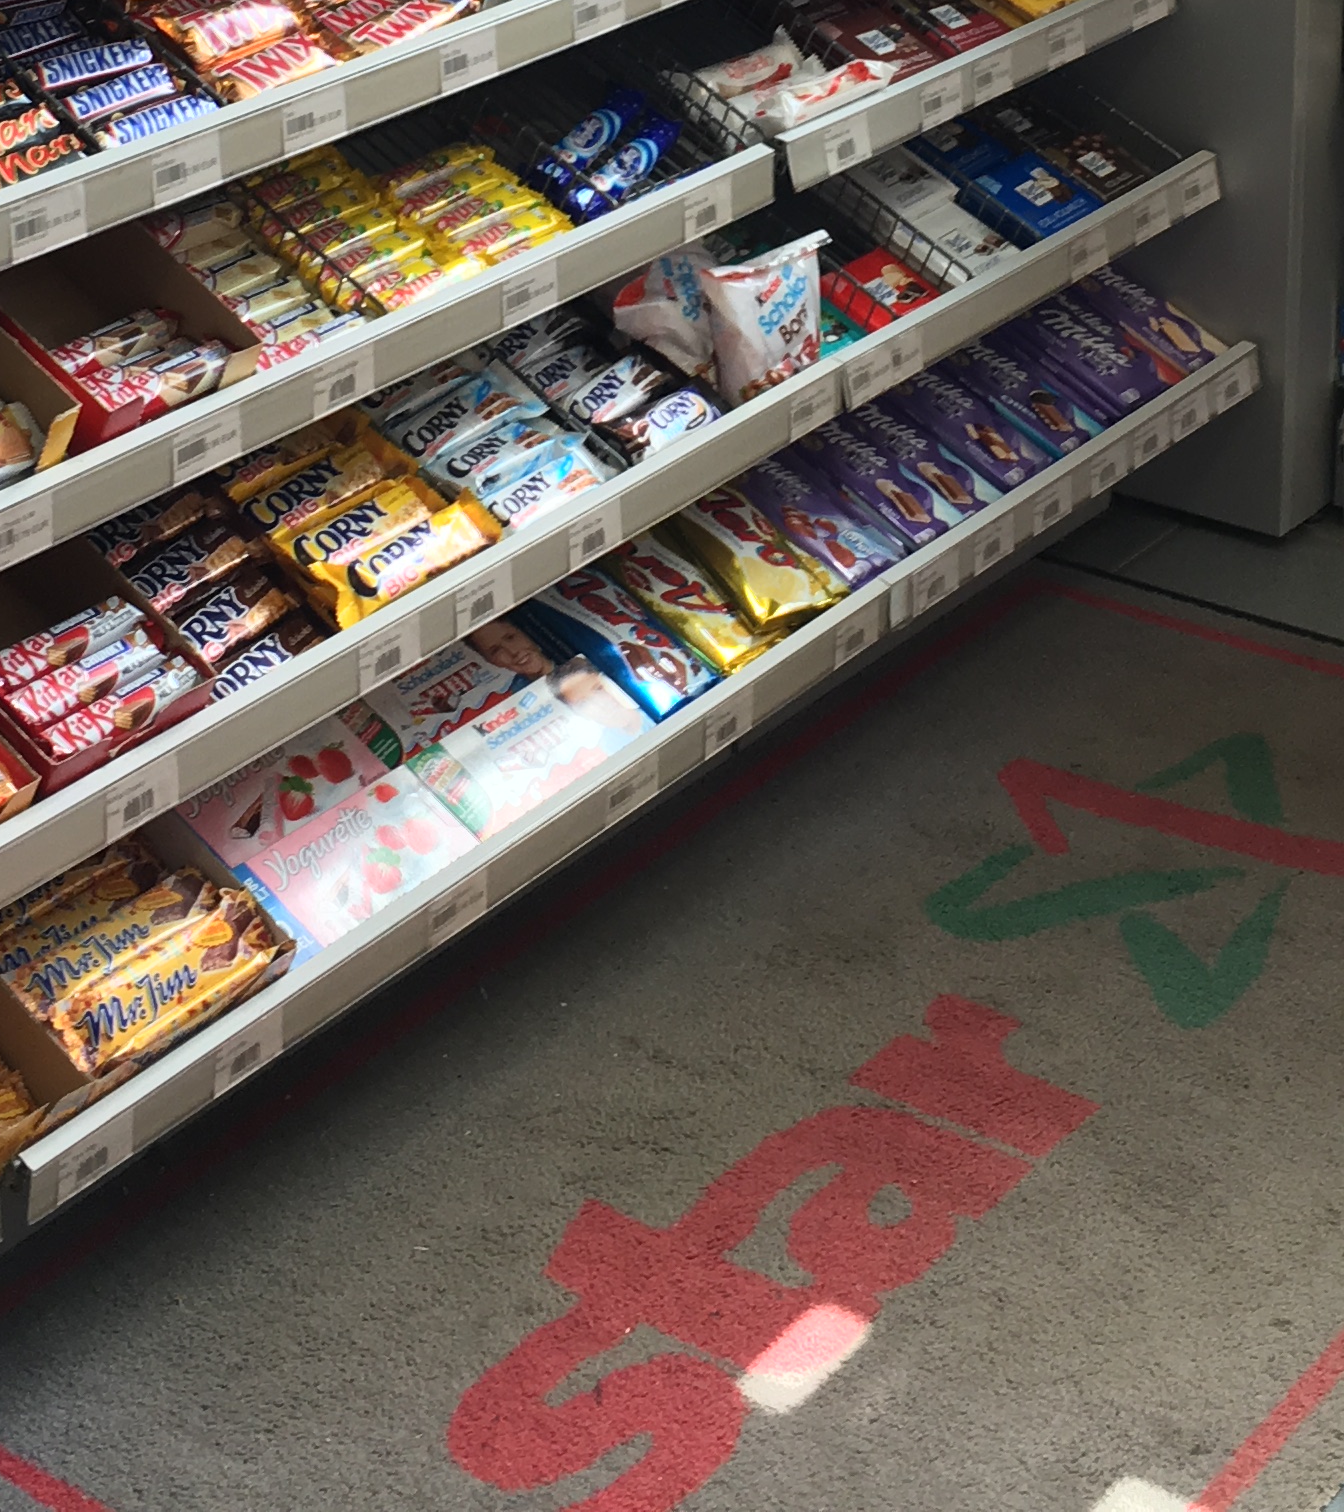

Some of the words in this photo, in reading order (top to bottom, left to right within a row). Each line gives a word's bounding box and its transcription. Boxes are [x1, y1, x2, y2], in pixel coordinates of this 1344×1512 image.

[355, 0, 443, 48] TWIX
[47, 37, 153, 87] SNICKERS
[1041, 305, 1132, 366] Milka
[568, 369, 625, 427] CORNY
[648, 390, 698, 430] CORNY
[402, 408, 469, 458] CORNY
[243, 458, 346, 532] CORNY
[282, 496, 320, 530] BIG
[55, 696, 116, 751] KitKat
[478, 707, 521, 736] Kinder
[488, 703, 554, 751] Schokolade
[266, 804, 373, 890] Yogurette
[84, 964, 196, 1042] Mr.Jim
[446, 994, 1101, 1512] star
